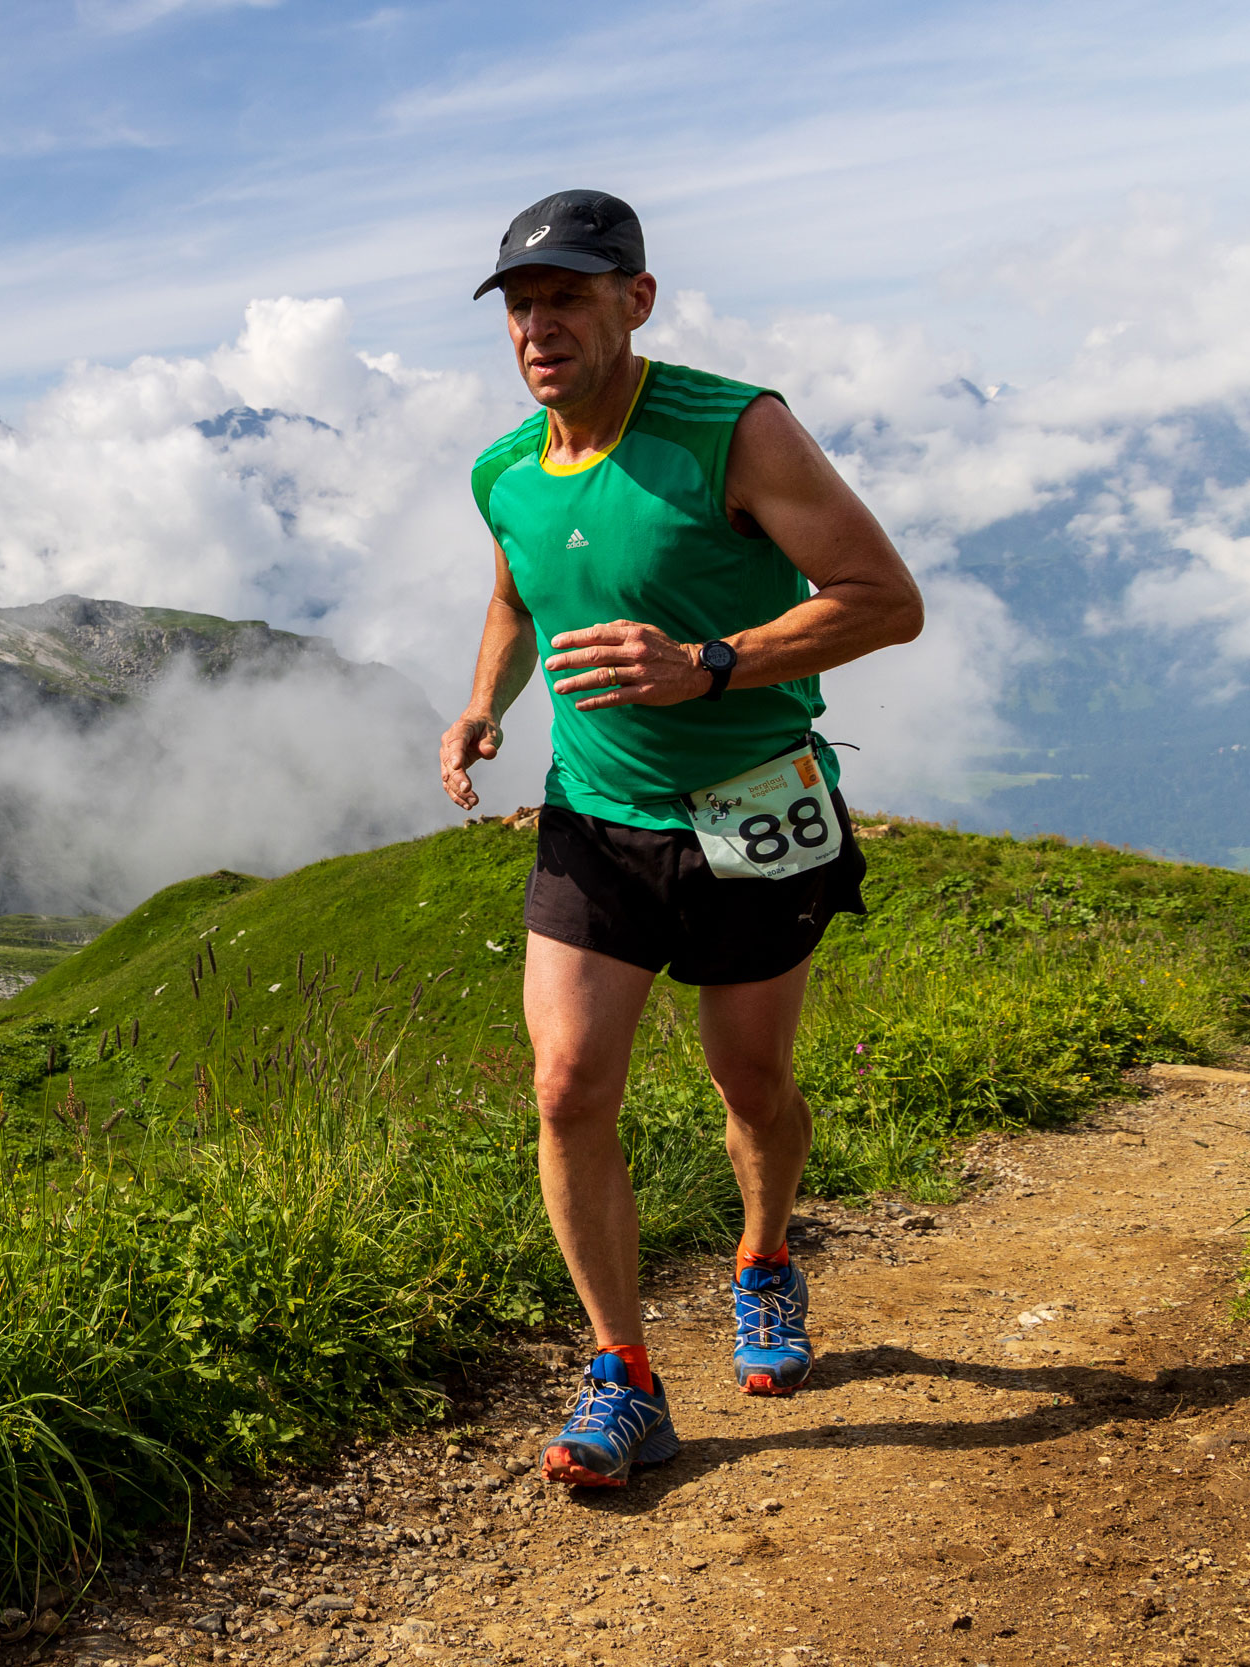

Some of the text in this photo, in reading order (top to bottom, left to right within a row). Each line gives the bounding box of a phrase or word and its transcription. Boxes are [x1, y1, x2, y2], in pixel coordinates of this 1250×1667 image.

[565, 540, 589, 550] adidas
[748, 774, 785, 793] berglauf
[751, 781, 788, 799] engelberg
[738, 796, 829, 865] 88
[766, 866, 786, 877] 2024
